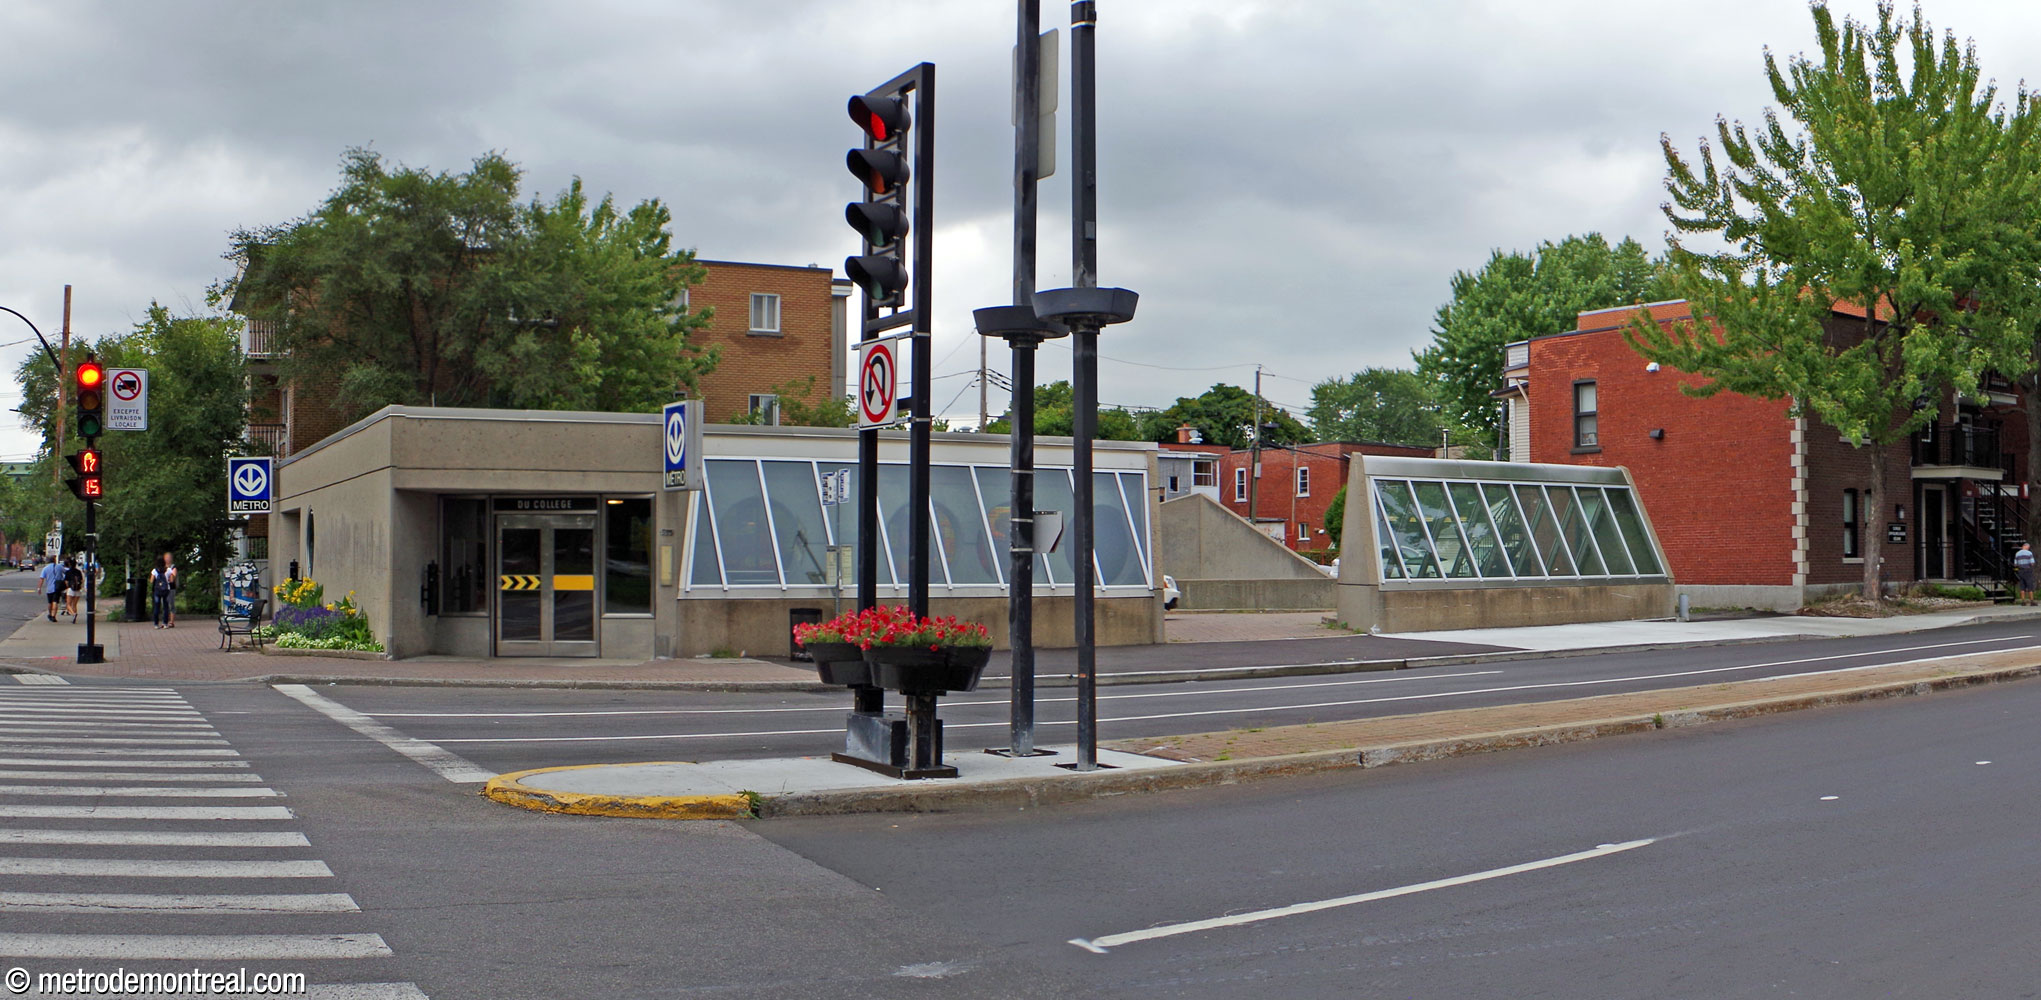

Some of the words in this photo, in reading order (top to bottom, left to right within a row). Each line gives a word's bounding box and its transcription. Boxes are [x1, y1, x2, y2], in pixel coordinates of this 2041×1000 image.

[86, 479, 100, 495] 15
[517, 500, 530, 509] DU
[47, 537, 61, 550] 40
